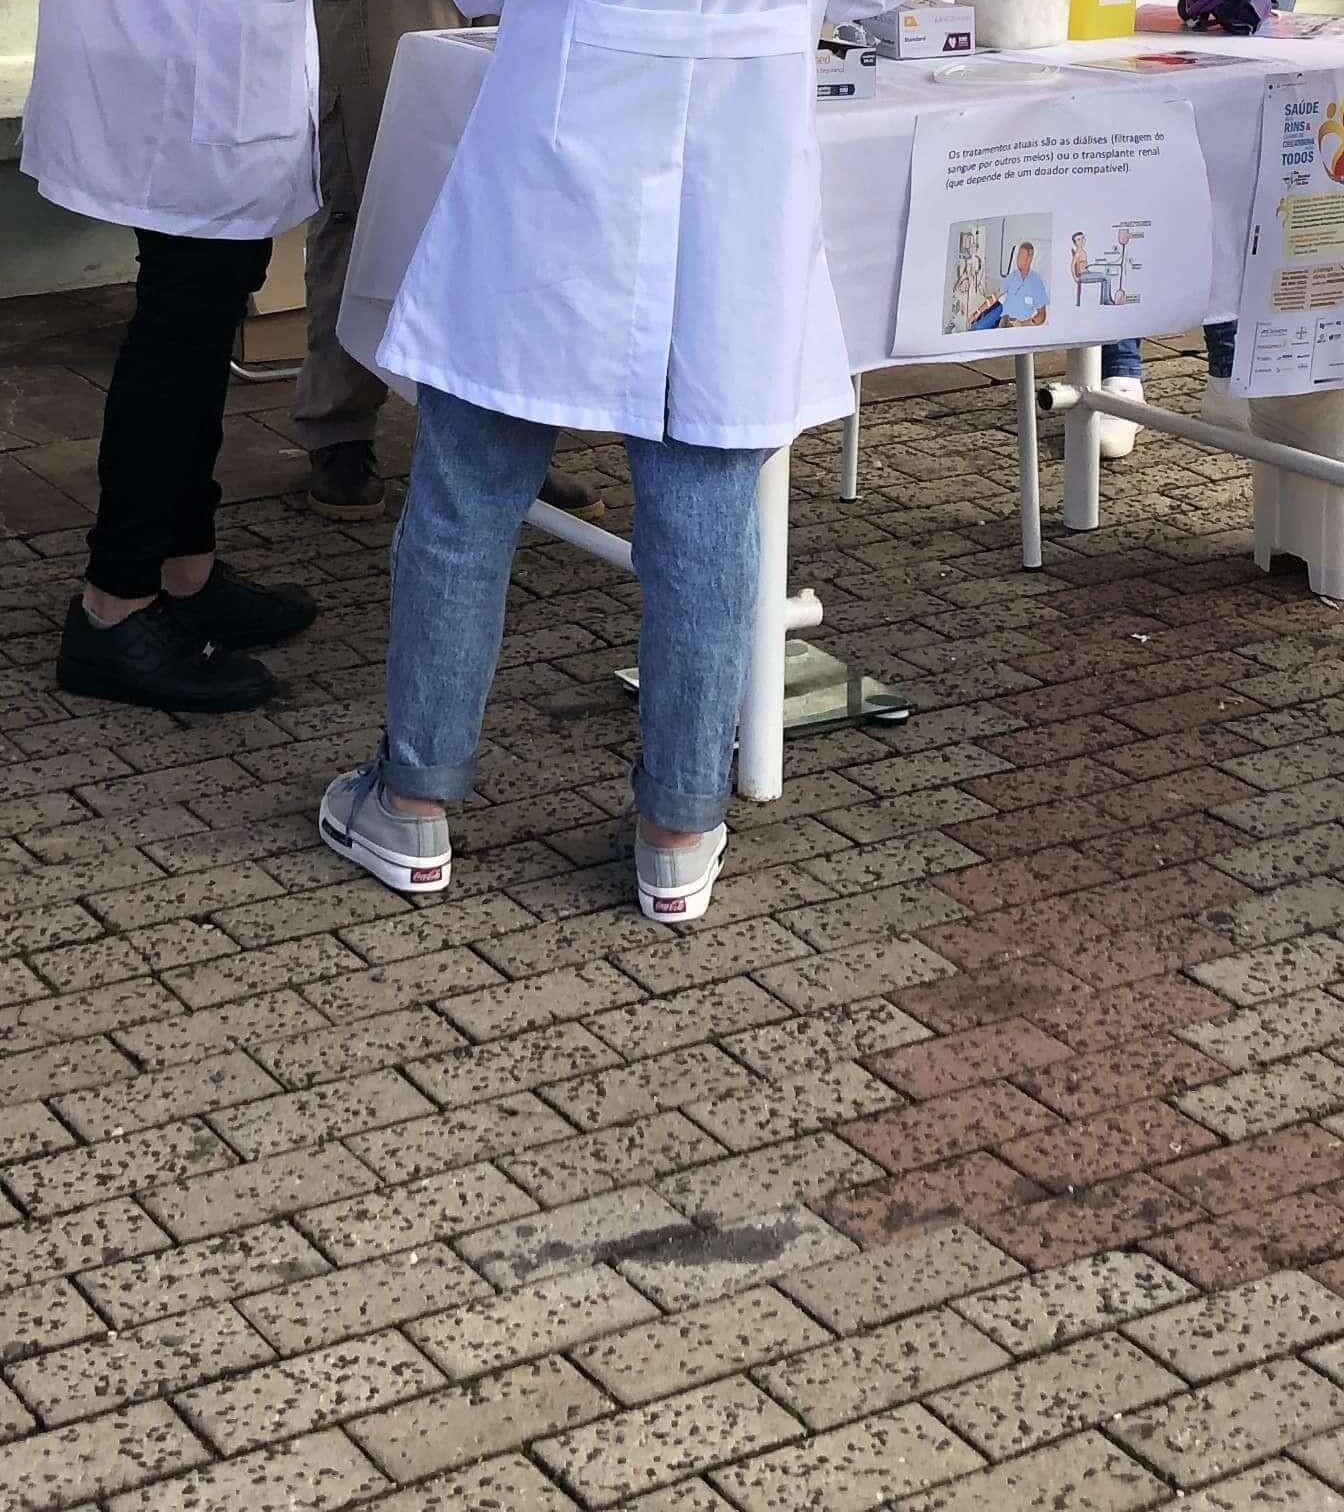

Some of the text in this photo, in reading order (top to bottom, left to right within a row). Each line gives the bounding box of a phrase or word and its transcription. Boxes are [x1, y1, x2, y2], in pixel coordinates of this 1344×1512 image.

[1284, 99, 1320, 116] SAÚDE
[1284, 121, 1305, 133] RINS
[948, 150, 960, 160] Os
[962, 144, 1011, 158] tratamentos
[1013, 140, 1038, 150] atuais
[1041, 137, 1057, 147] são
[1073, 135, 1107, 145] diálises
[1111, 133, 1152, 145] (filtragem
[1154, 132, 1165, 141] do
[947, 163, 976, 174] sangue
[978, 160, 993, 171] por
[994, 156, 1021, 167] outros
[1023, 151, 1054, 163] meios)
[1056, 152, 1070, 161] ou
[1081, 149, 1134, 160] transplante
[1138, 146, 1160, 156] renal
[1281, 151, 1314, 166] TODOS
[946, 178, 965, 190] (que
[966, 172, 1002, 185] depende
[1004, 170, 1015, 179] de
[1017, 169, 1032, 178] um
[1034, 165, 1068, 176] doador
